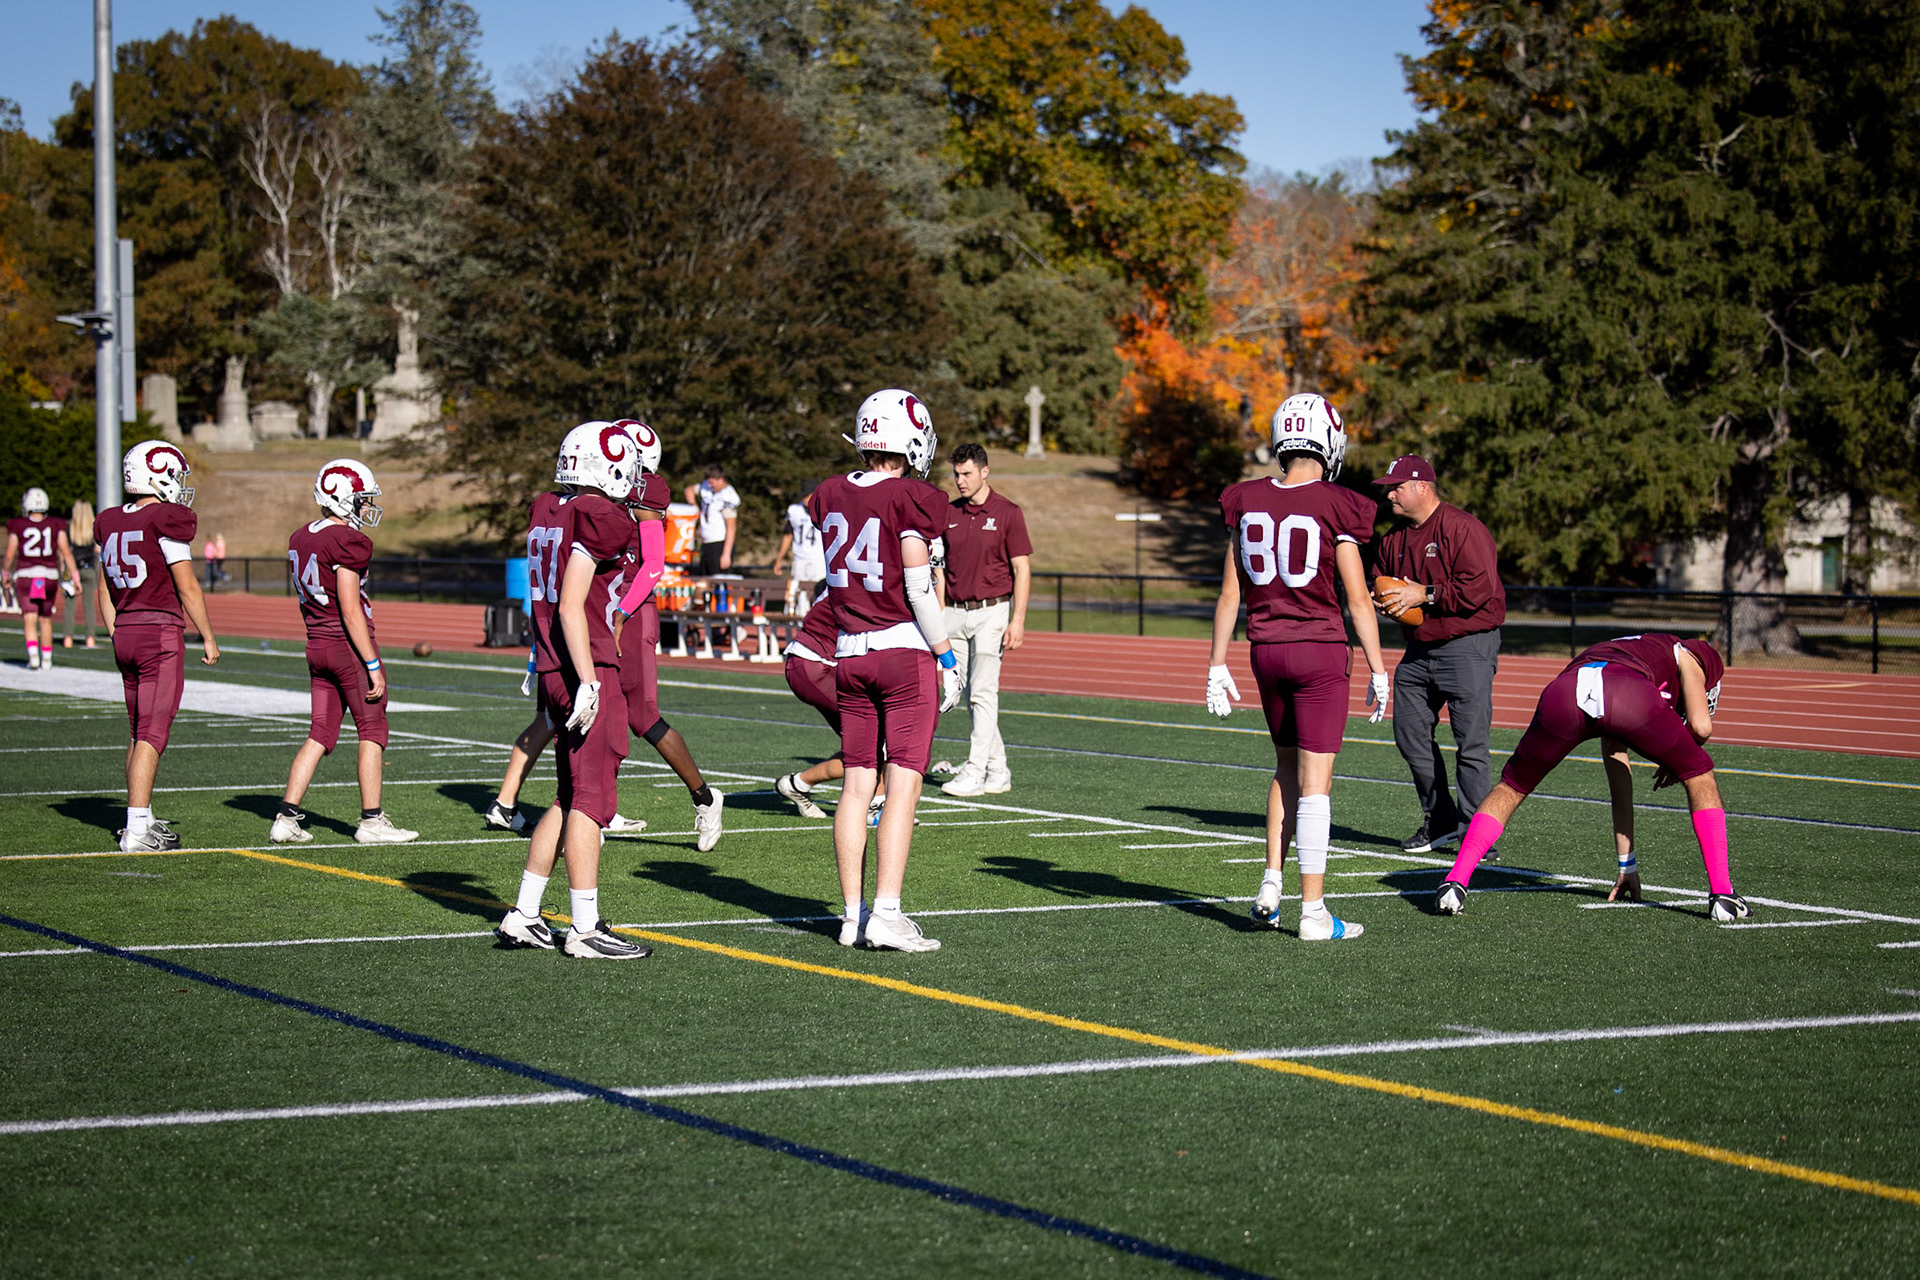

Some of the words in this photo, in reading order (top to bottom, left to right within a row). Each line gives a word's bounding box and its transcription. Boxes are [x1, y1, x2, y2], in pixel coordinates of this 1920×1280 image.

[862, 418, 879, 434] 24
[1284, 418, 1306, 433] 80
[22, 526, 53, 558] 21
[101, 530, 148, 590] 45
[526, 525, 564, 604] 87
[822, 512, 884, 592] 24
[1240, 511, 1321, 588] 80
